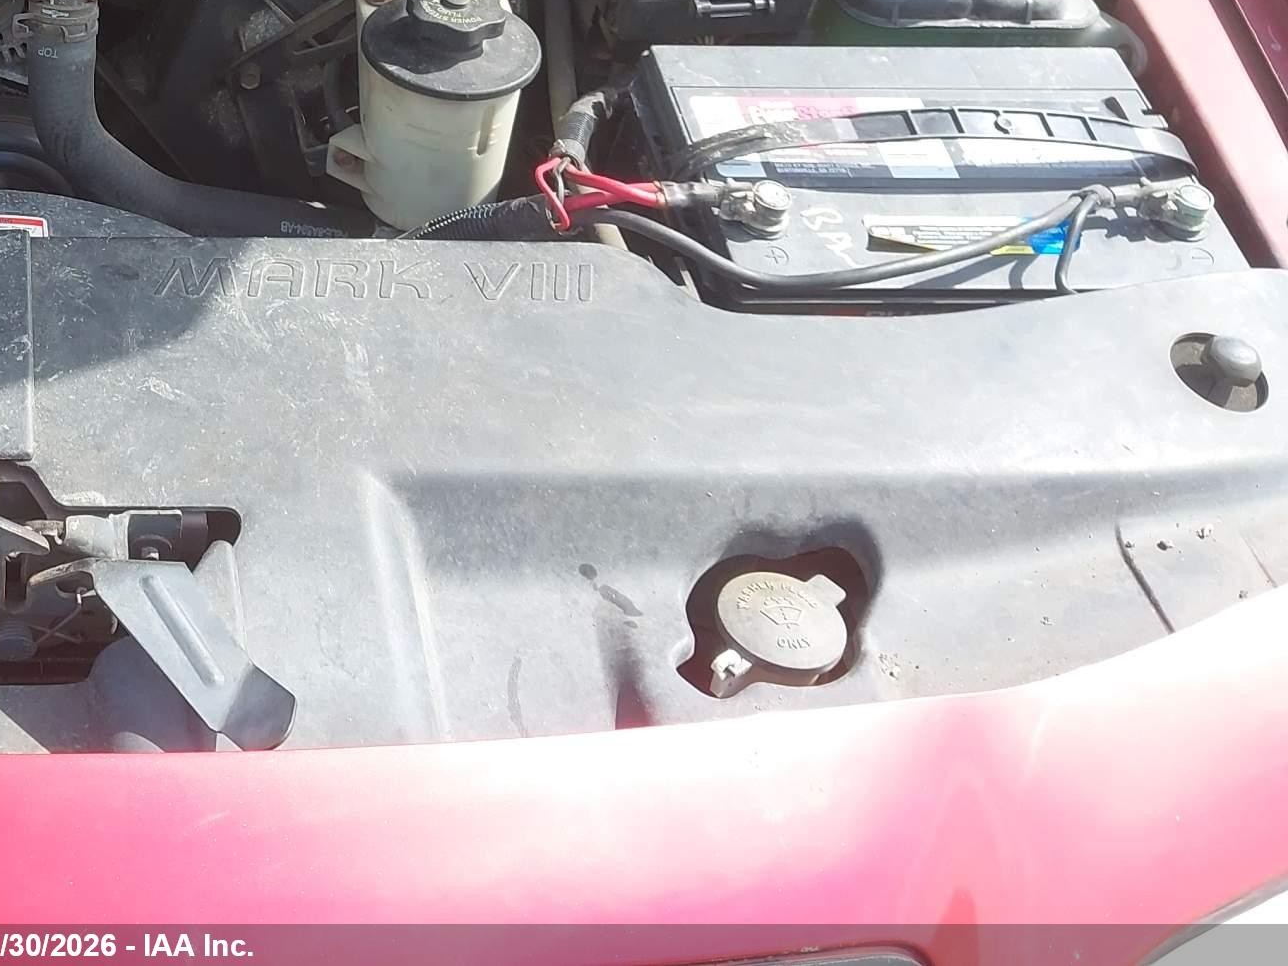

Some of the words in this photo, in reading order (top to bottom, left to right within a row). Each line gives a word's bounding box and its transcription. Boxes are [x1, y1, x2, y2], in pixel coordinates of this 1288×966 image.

[450, 15, 482, 24] POWER
[38, 46, 58, 59] TOP
[154, 256, 433, 300] MARK
[462, 261, 594, 303] VIII
[776, 636, 811, 650] ONLY
